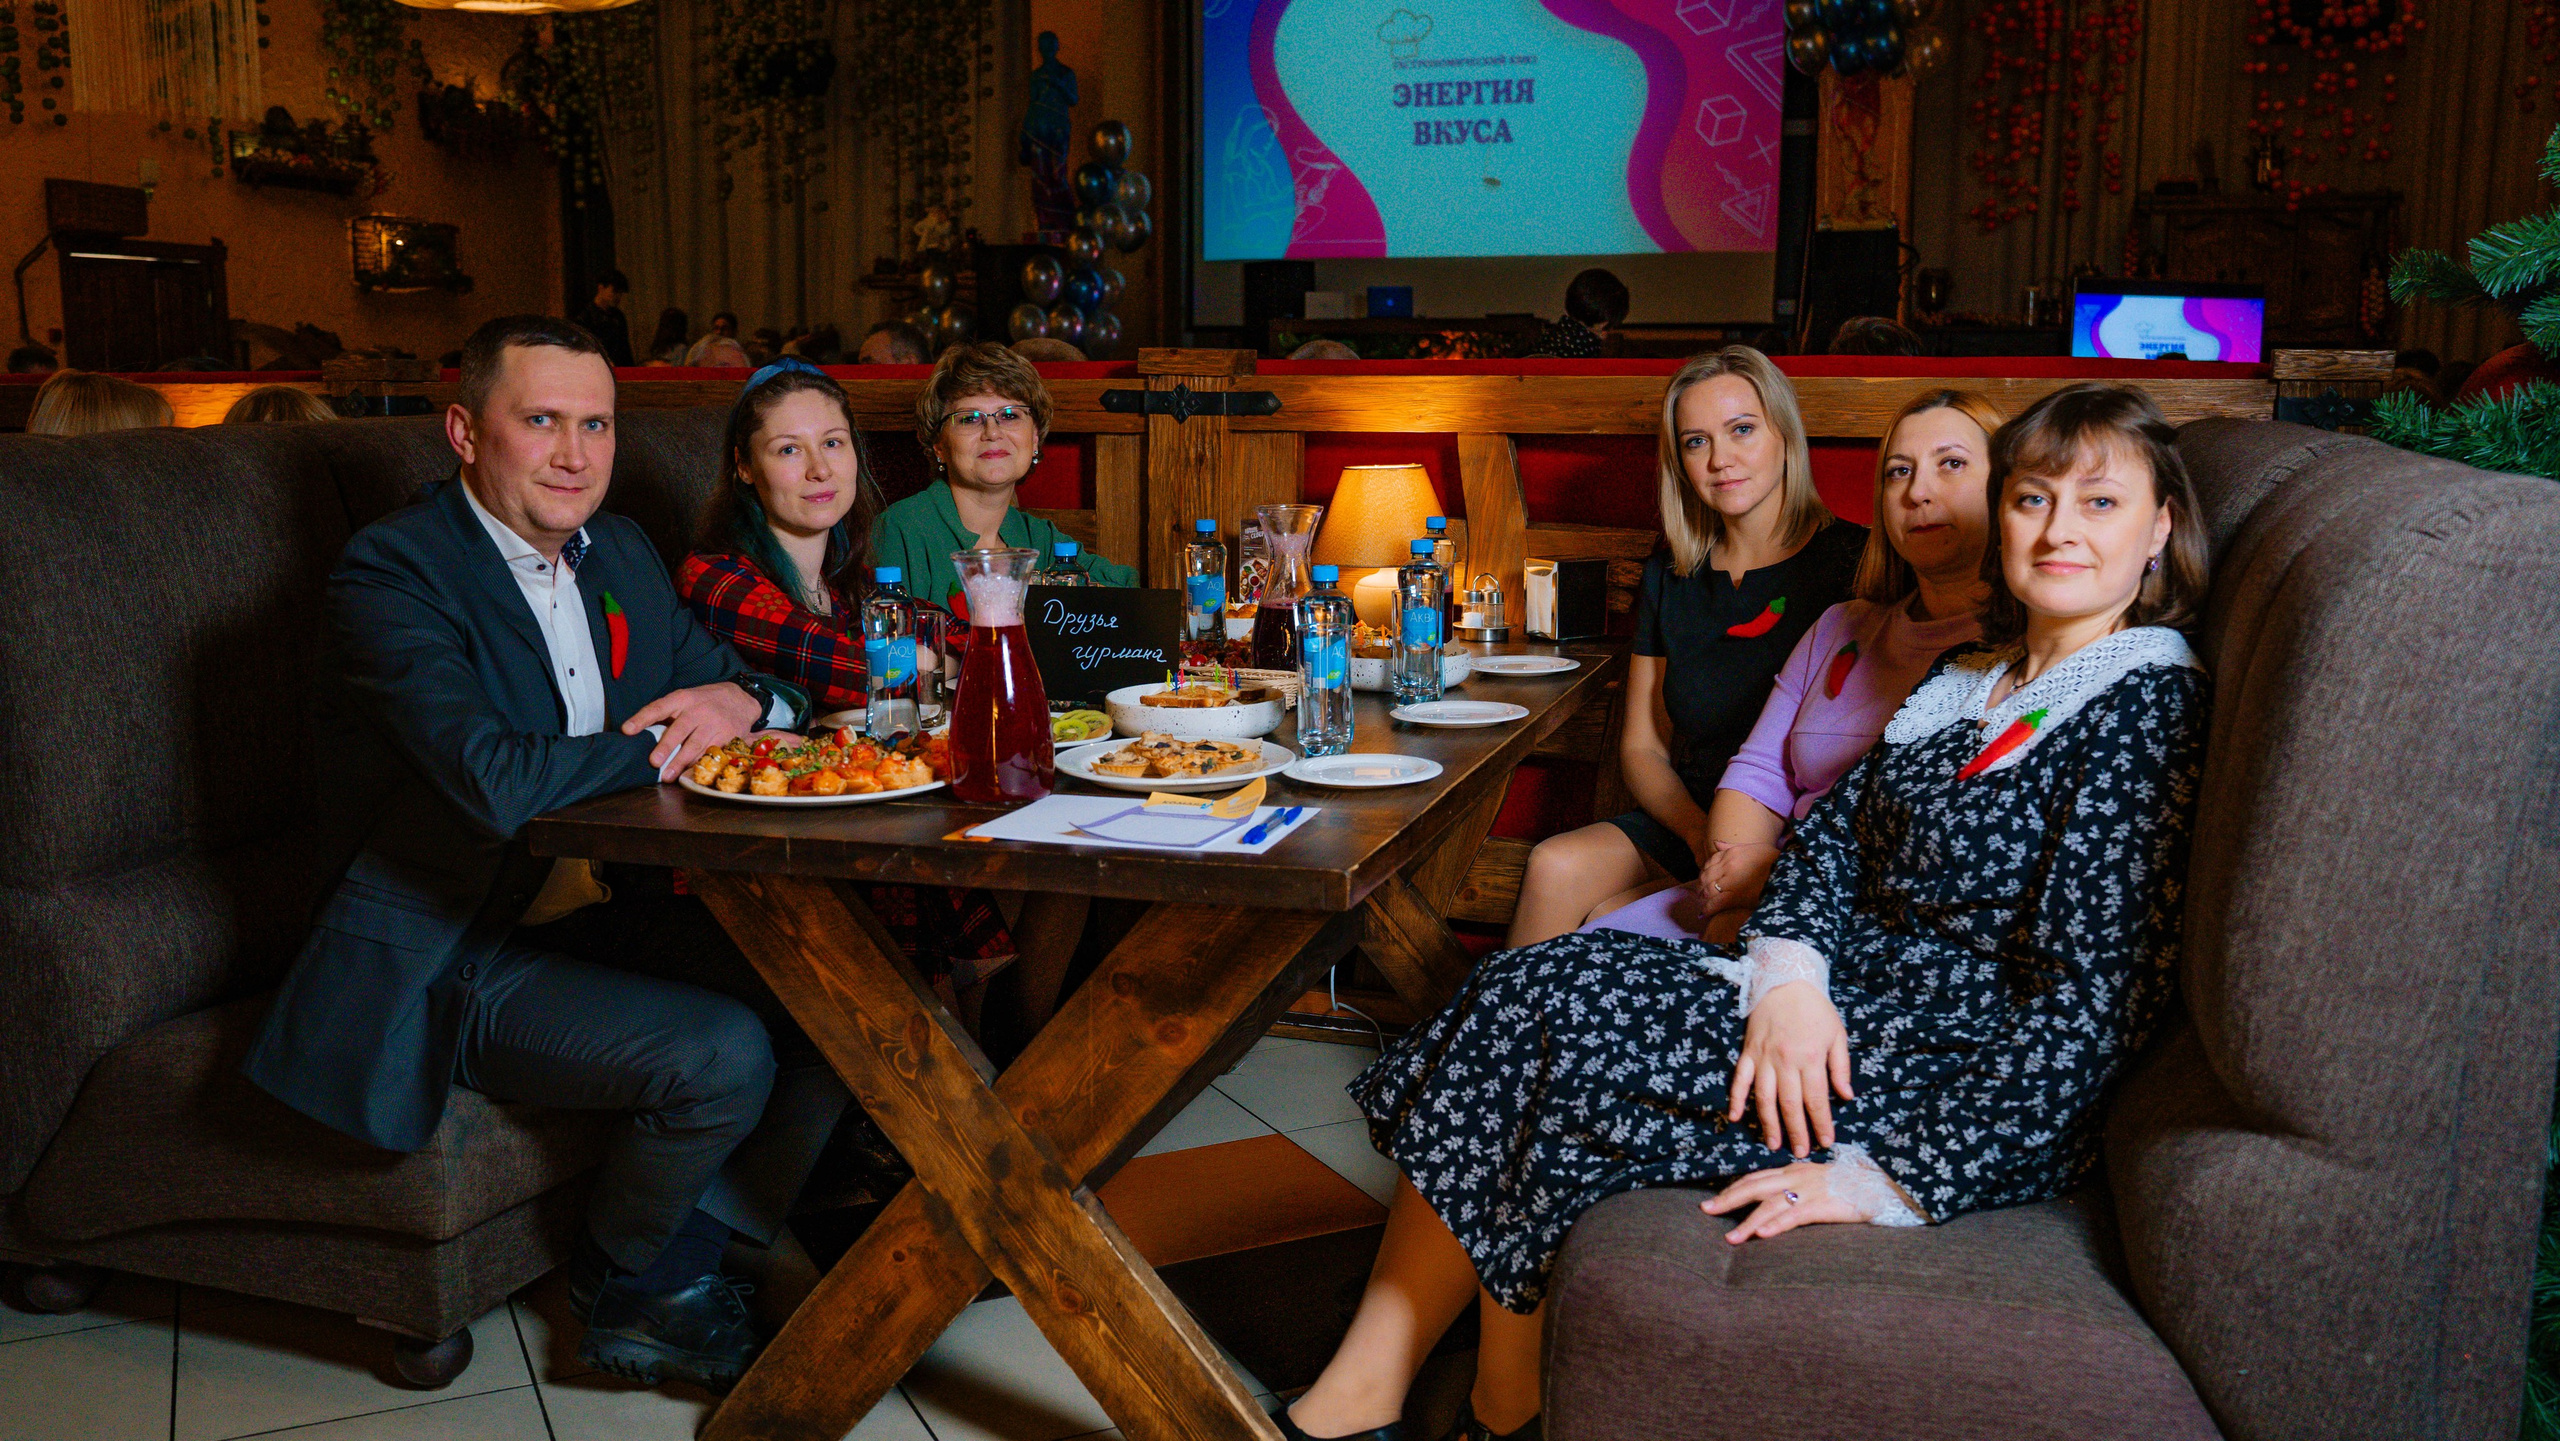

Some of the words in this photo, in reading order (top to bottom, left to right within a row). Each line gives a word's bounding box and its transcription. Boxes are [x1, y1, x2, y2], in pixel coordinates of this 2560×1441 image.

[1393, 78, 1535, 108] ЭНЕРГИЯ
[1413, 118, 1513, 145] ВКУСА
[1043, 599, 1119, 635] Друзья
[1071, 645, 1168, 670] гурмана
